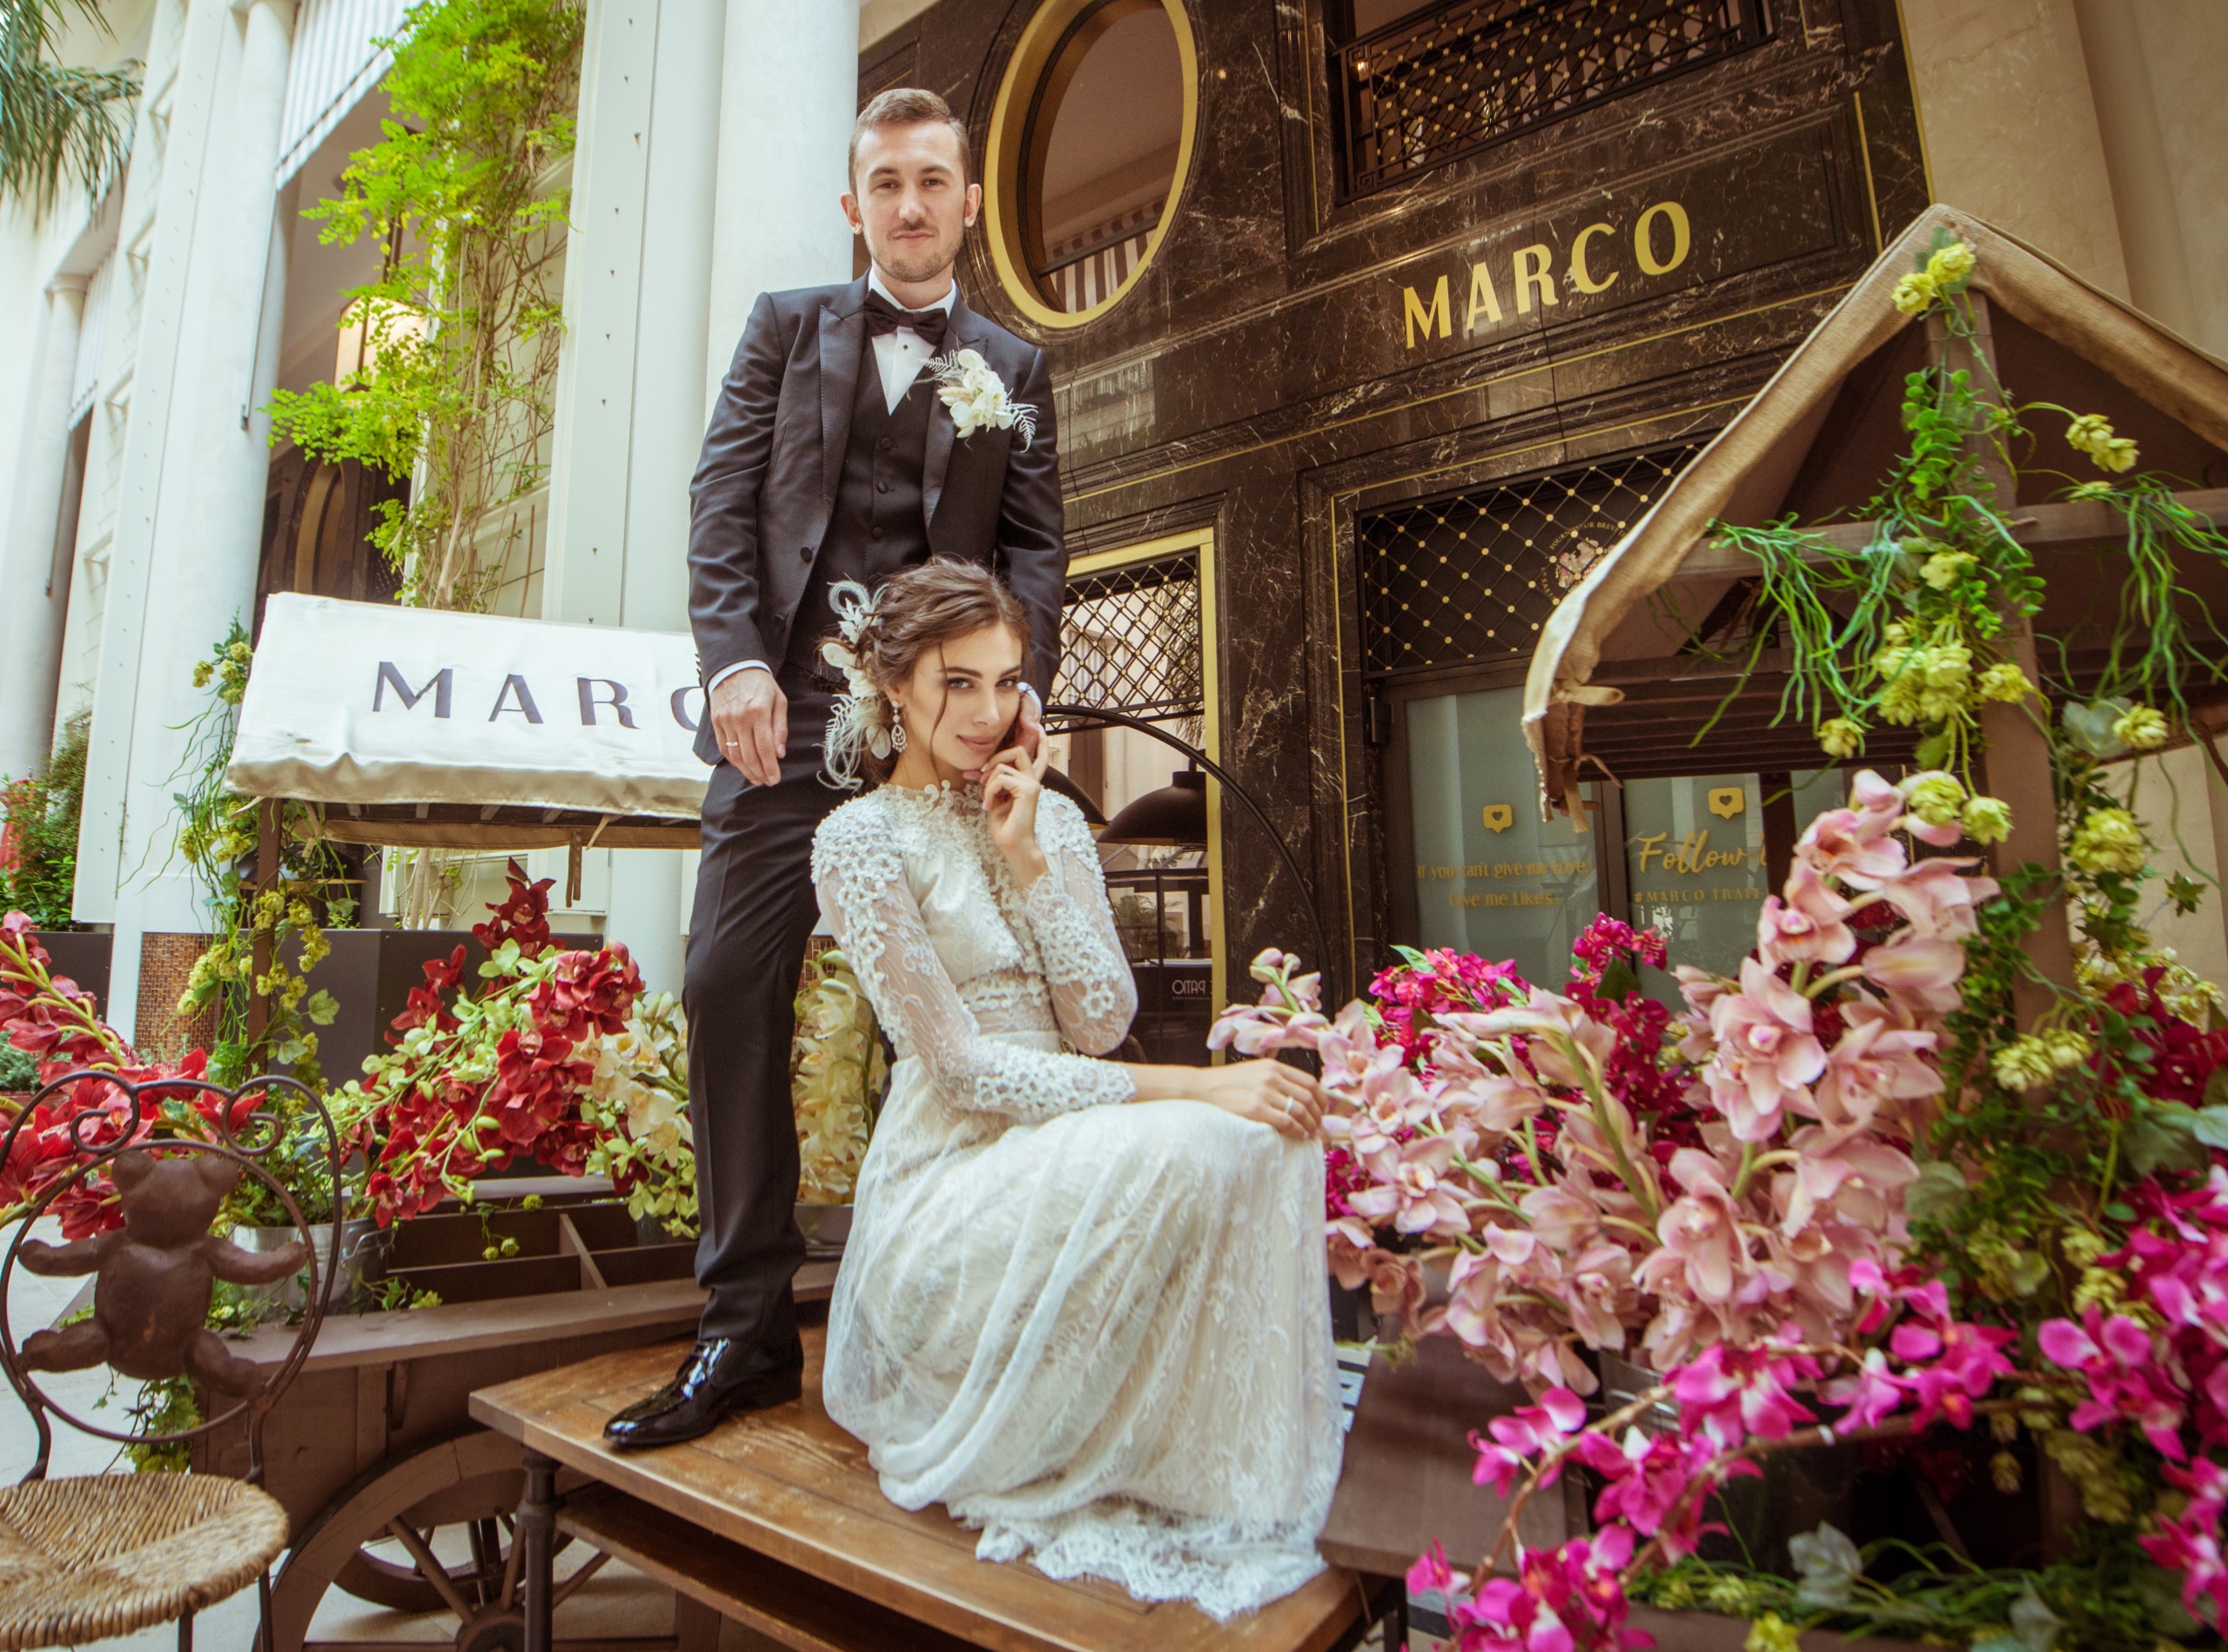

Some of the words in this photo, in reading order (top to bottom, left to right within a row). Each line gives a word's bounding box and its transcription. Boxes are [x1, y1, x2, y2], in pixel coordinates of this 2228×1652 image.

[1403, 201, 1690, 348] MARCO
[1636, 829, 1750, 875] Follow
[1417, 863, 1426, 878] If
[1431, 865, 1455, 880] you
[1493, 862, 1523, 879] give
[1527, 863, 1548, 876] me
[1448, 892, 1480, 907] Give
[1485, 893, 1508, 906] me
[1634, 890, 1705, 903] #MARCO
[1713, 888, 1769, 901] TRAVE
